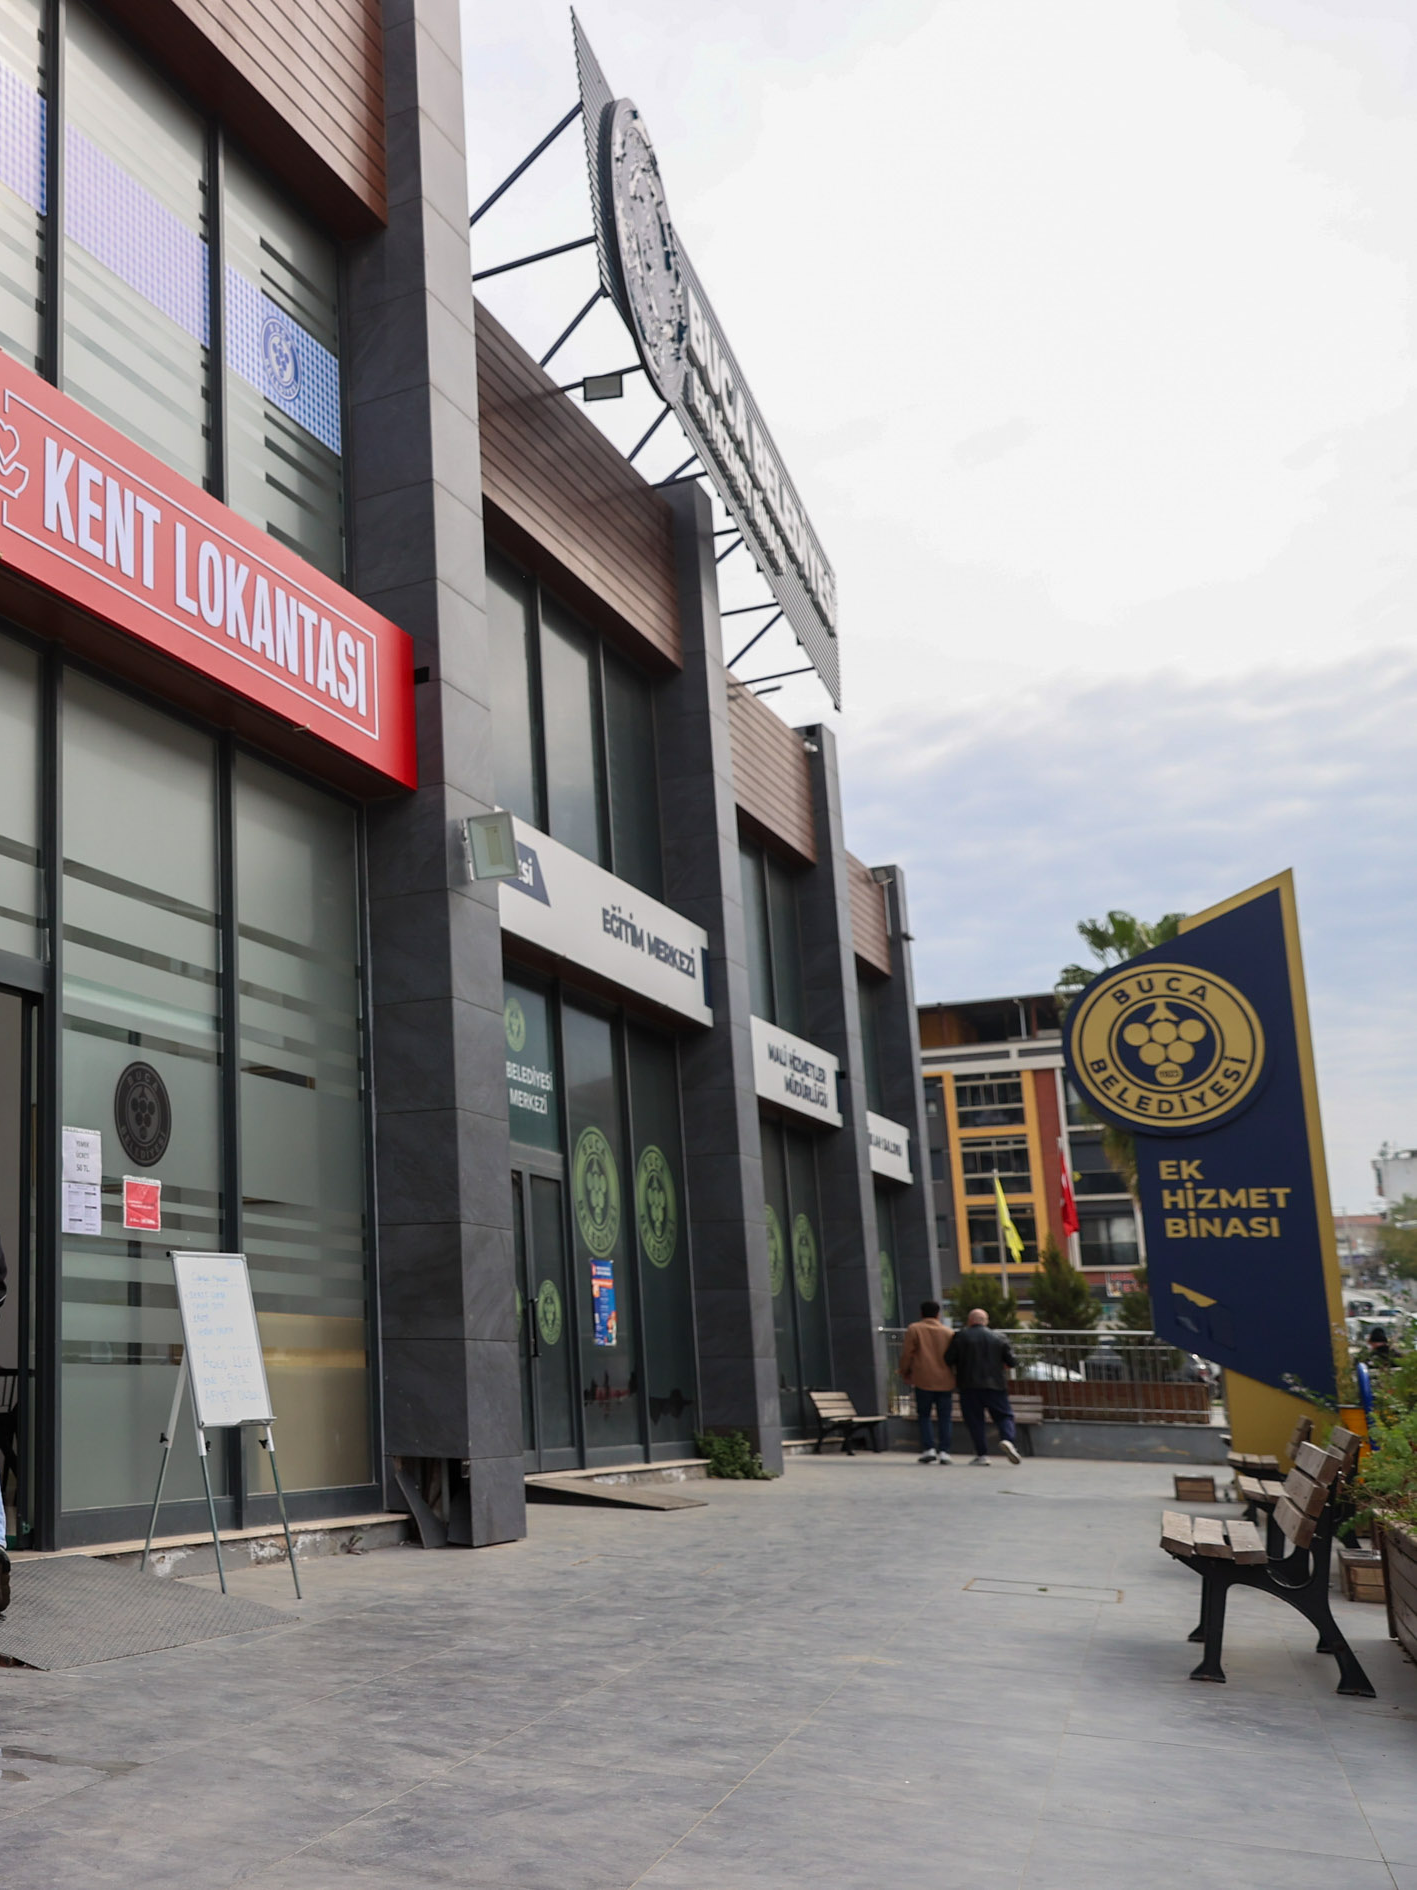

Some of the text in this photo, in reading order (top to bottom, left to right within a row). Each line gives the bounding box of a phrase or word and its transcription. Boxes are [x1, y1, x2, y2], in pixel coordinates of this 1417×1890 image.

[687, 284, 751, 463] BUCA
[44, 436, 368, 717] KENT LOKANTASI
[602, 904, 696, 979] EĞİTİM MERKEZİ
[1112, 977, 1208, 1006] BUCA
[506, 1061, 553, 1092] BELEDİYESİ
[1089, 1055, 1248, 1115] BELEDİYESİ
[509, 1087, 548, 1115] MERKEZİ
[1158, 1160, 1205, 1181] EK
[1161, 1181, 1292, 1210] HİZMET
[1164, 1210, 1281, 1239] BİNASI
